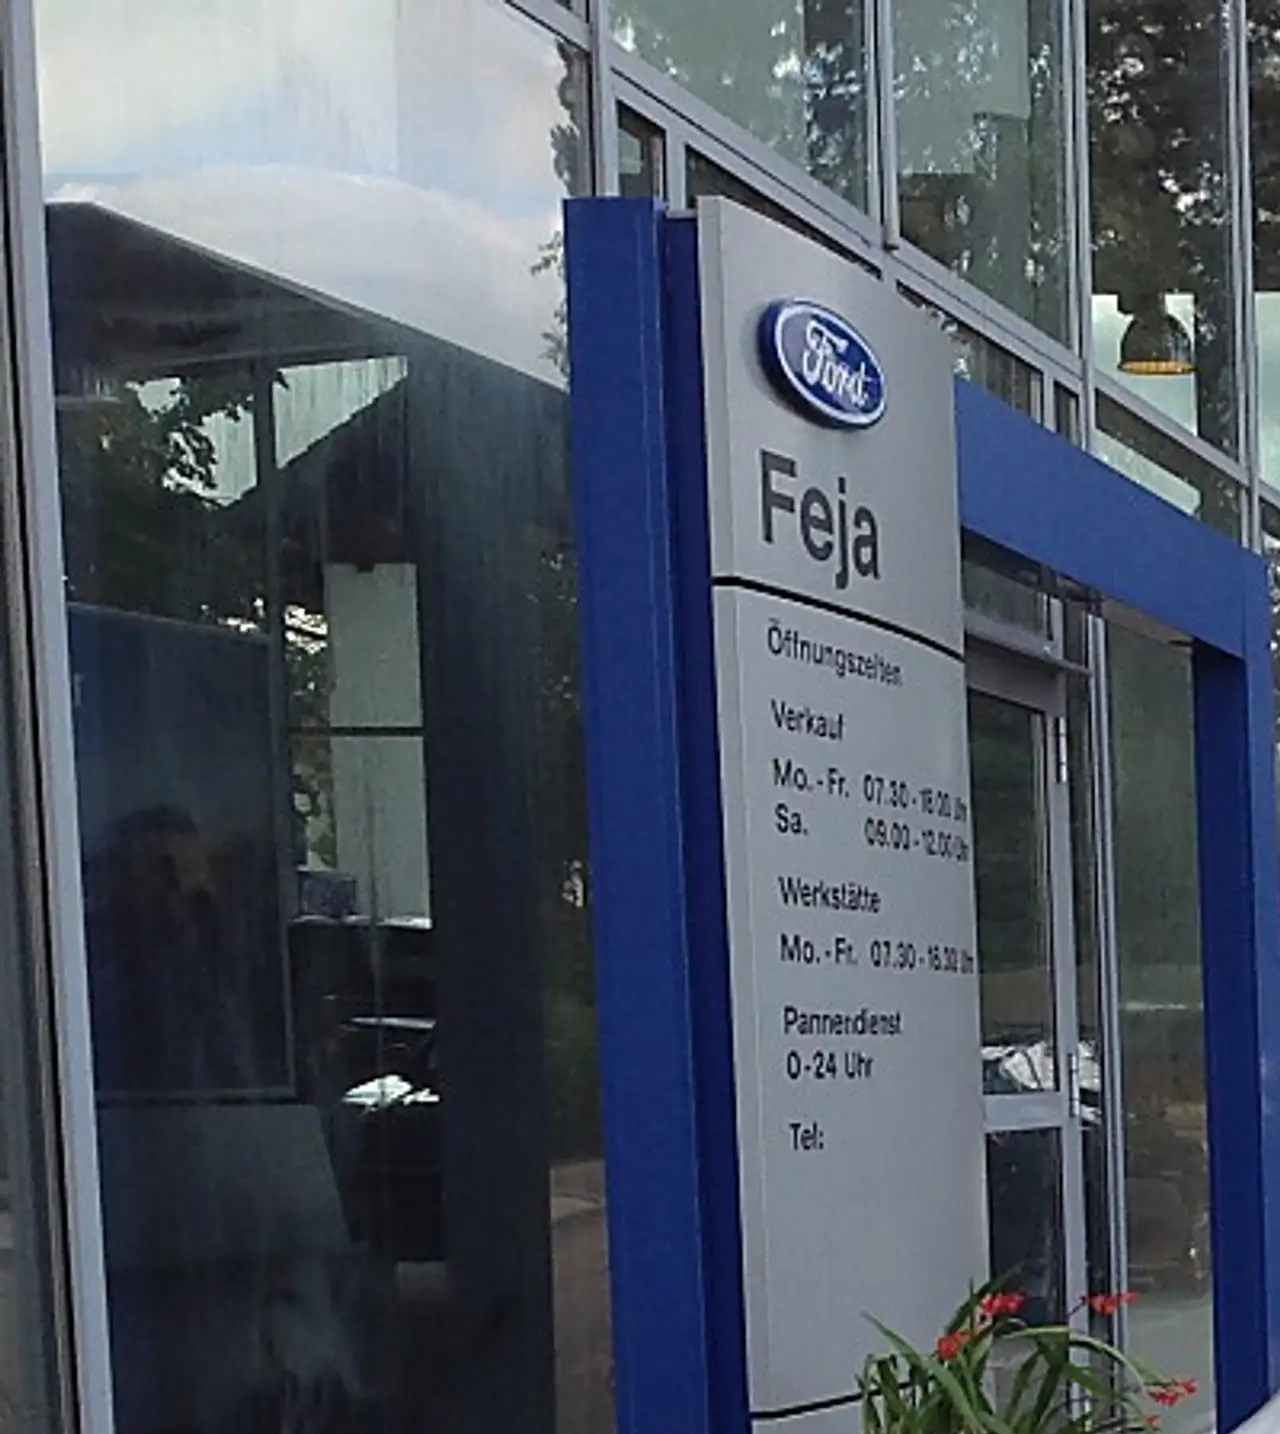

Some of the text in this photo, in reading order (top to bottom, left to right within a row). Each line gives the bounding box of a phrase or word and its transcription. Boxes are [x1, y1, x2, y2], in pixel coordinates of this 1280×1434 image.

[803, 318, 870, 407] Ford
[760, 449, 879, 590] Feja
[768, 618, 902, 685] Öffnungszeiten
[771, 698, 843, 740] Verkauf
[775, 803, 808, 835] Sa.
[778, 877, 881, 914] Werkstätte
[784, 1005, 902, 1036] Pannendienst
[844, 1052, 874, 1080] Uhr
[789, 1122, 824, 1151] Tel:
